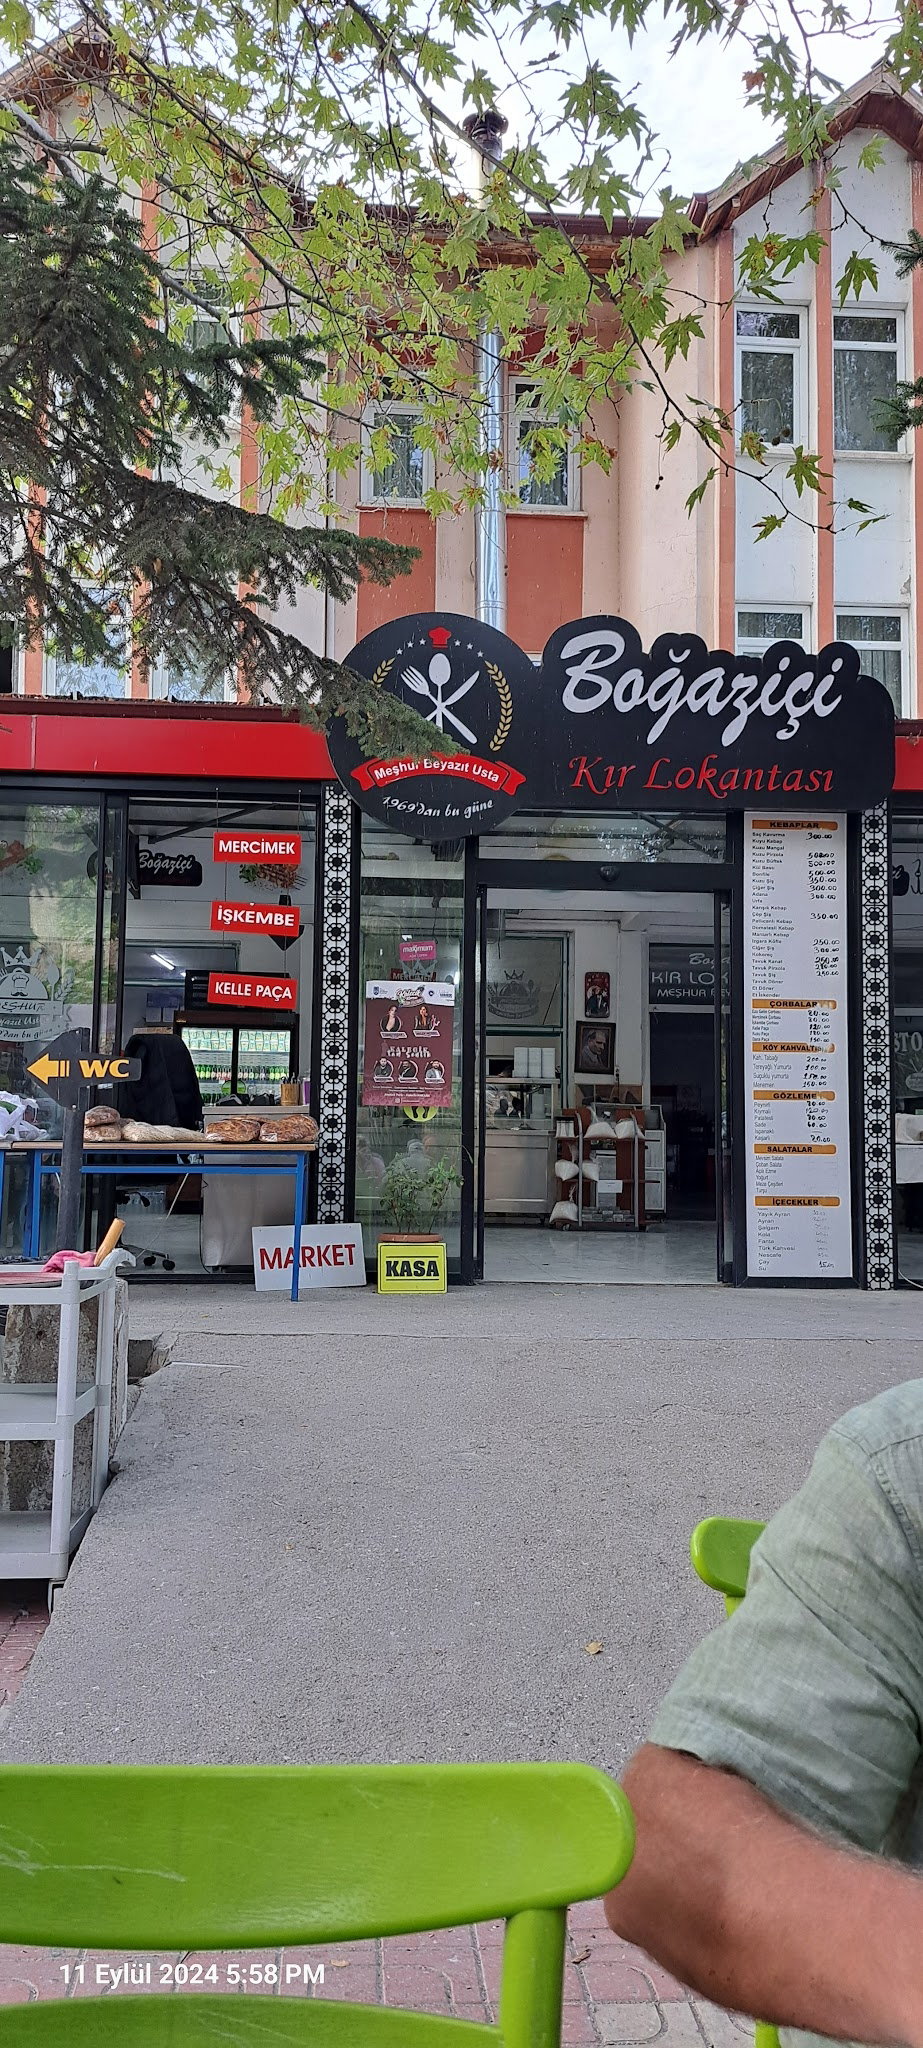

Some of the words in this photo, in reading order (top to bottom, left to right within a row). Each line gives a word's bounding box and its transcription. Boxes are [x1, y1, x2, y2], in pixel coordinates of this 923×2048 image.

[560, 629, 843, 747] Boğaziçi
[374, 760, 419, 780] Meşhur
[423, 758, 470, 772] Beyazıt
[472, 762, 500, 783] Usta
[568, 755, 637, 796] Kır
[642, 754, 834, 800] Lokantası
[382, 796, 441, 817] 1969'dan
[445, 806, 460, 817] bu
[464, 799, 494, 819] güne
[769, 821, 819, 829] KEBAPLAR
[219, 838, 295, 855] MERCİMEK
[139, 852, 192, 874] Boğaziçi
[217, 905, 295, 926] İŞKEMBE
[651, 971, 681, 984] KIR
[215, 981, 252, 997] KELLE
[256, 985, 292, 1001] PAÇA
[657, 989, 706, 998] MEŞHUR
[0, 1001, 45, 1012] EŞHUR
[769, 1000, 818, 1008] ÇORBALAR
[79, 1059, 130, 1078] WC
[772, 1197, 819, 1206] İÇECEKLER
[260, 1243, 356, 1270] MARKET
[385, 1260, 440, 1277] KASA
